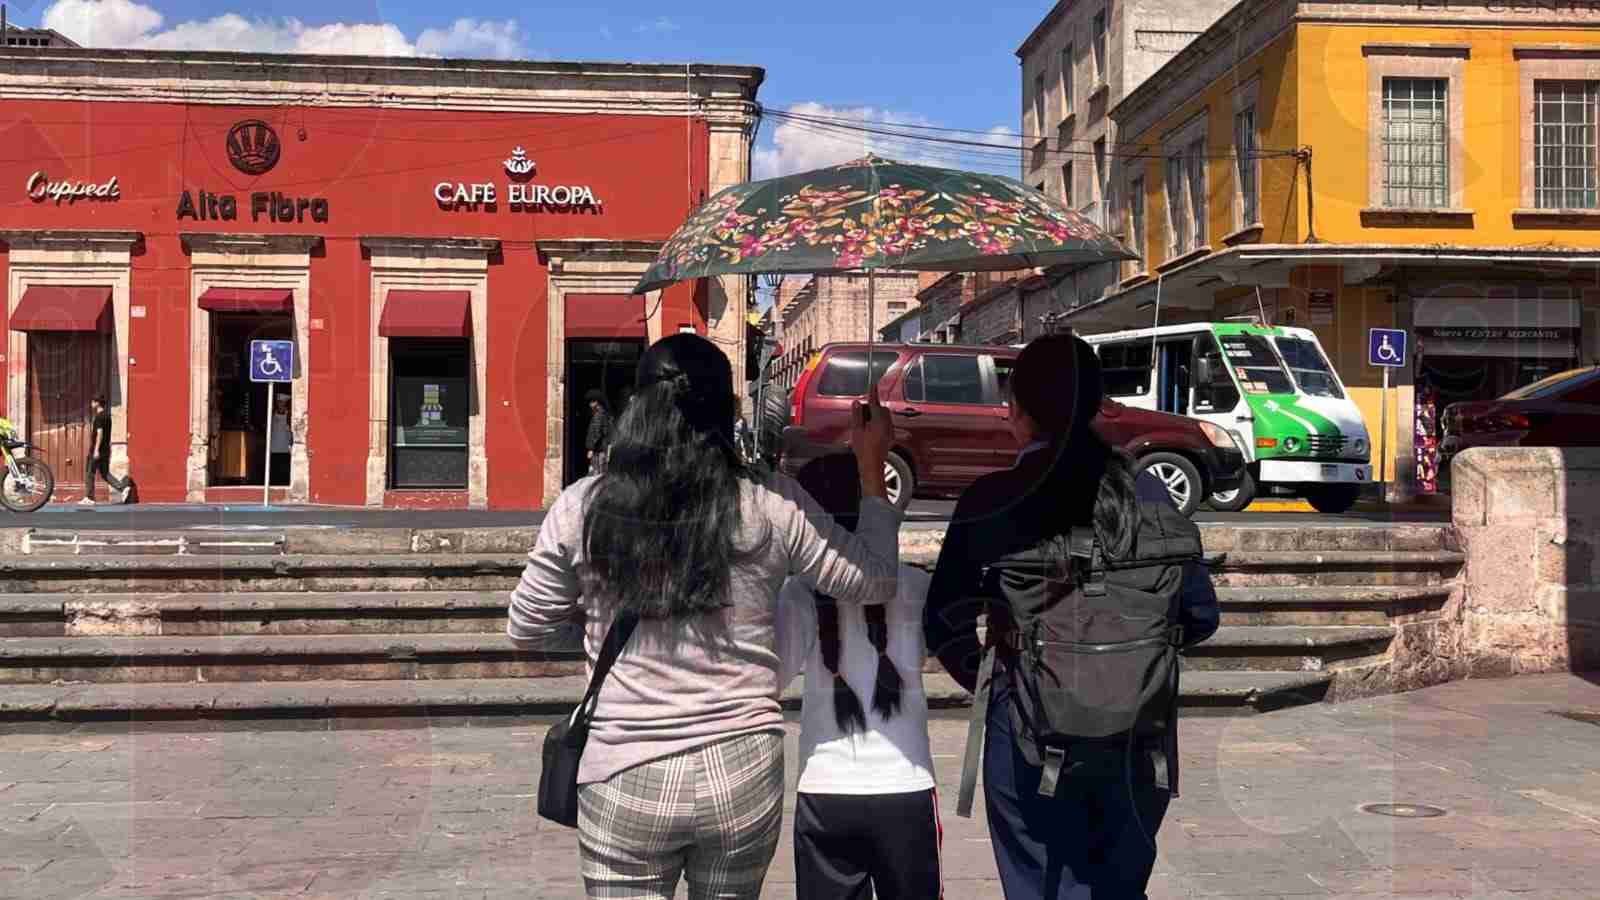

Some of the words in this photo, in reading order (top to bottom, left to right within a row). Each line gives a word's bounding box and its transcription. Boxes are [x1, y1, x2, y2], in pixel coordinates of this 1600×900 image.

[176, 190, 237, 221] Alta
[251, 191, 329, 223] Fibra
[434, 182, 497, 205] CAFÉ
